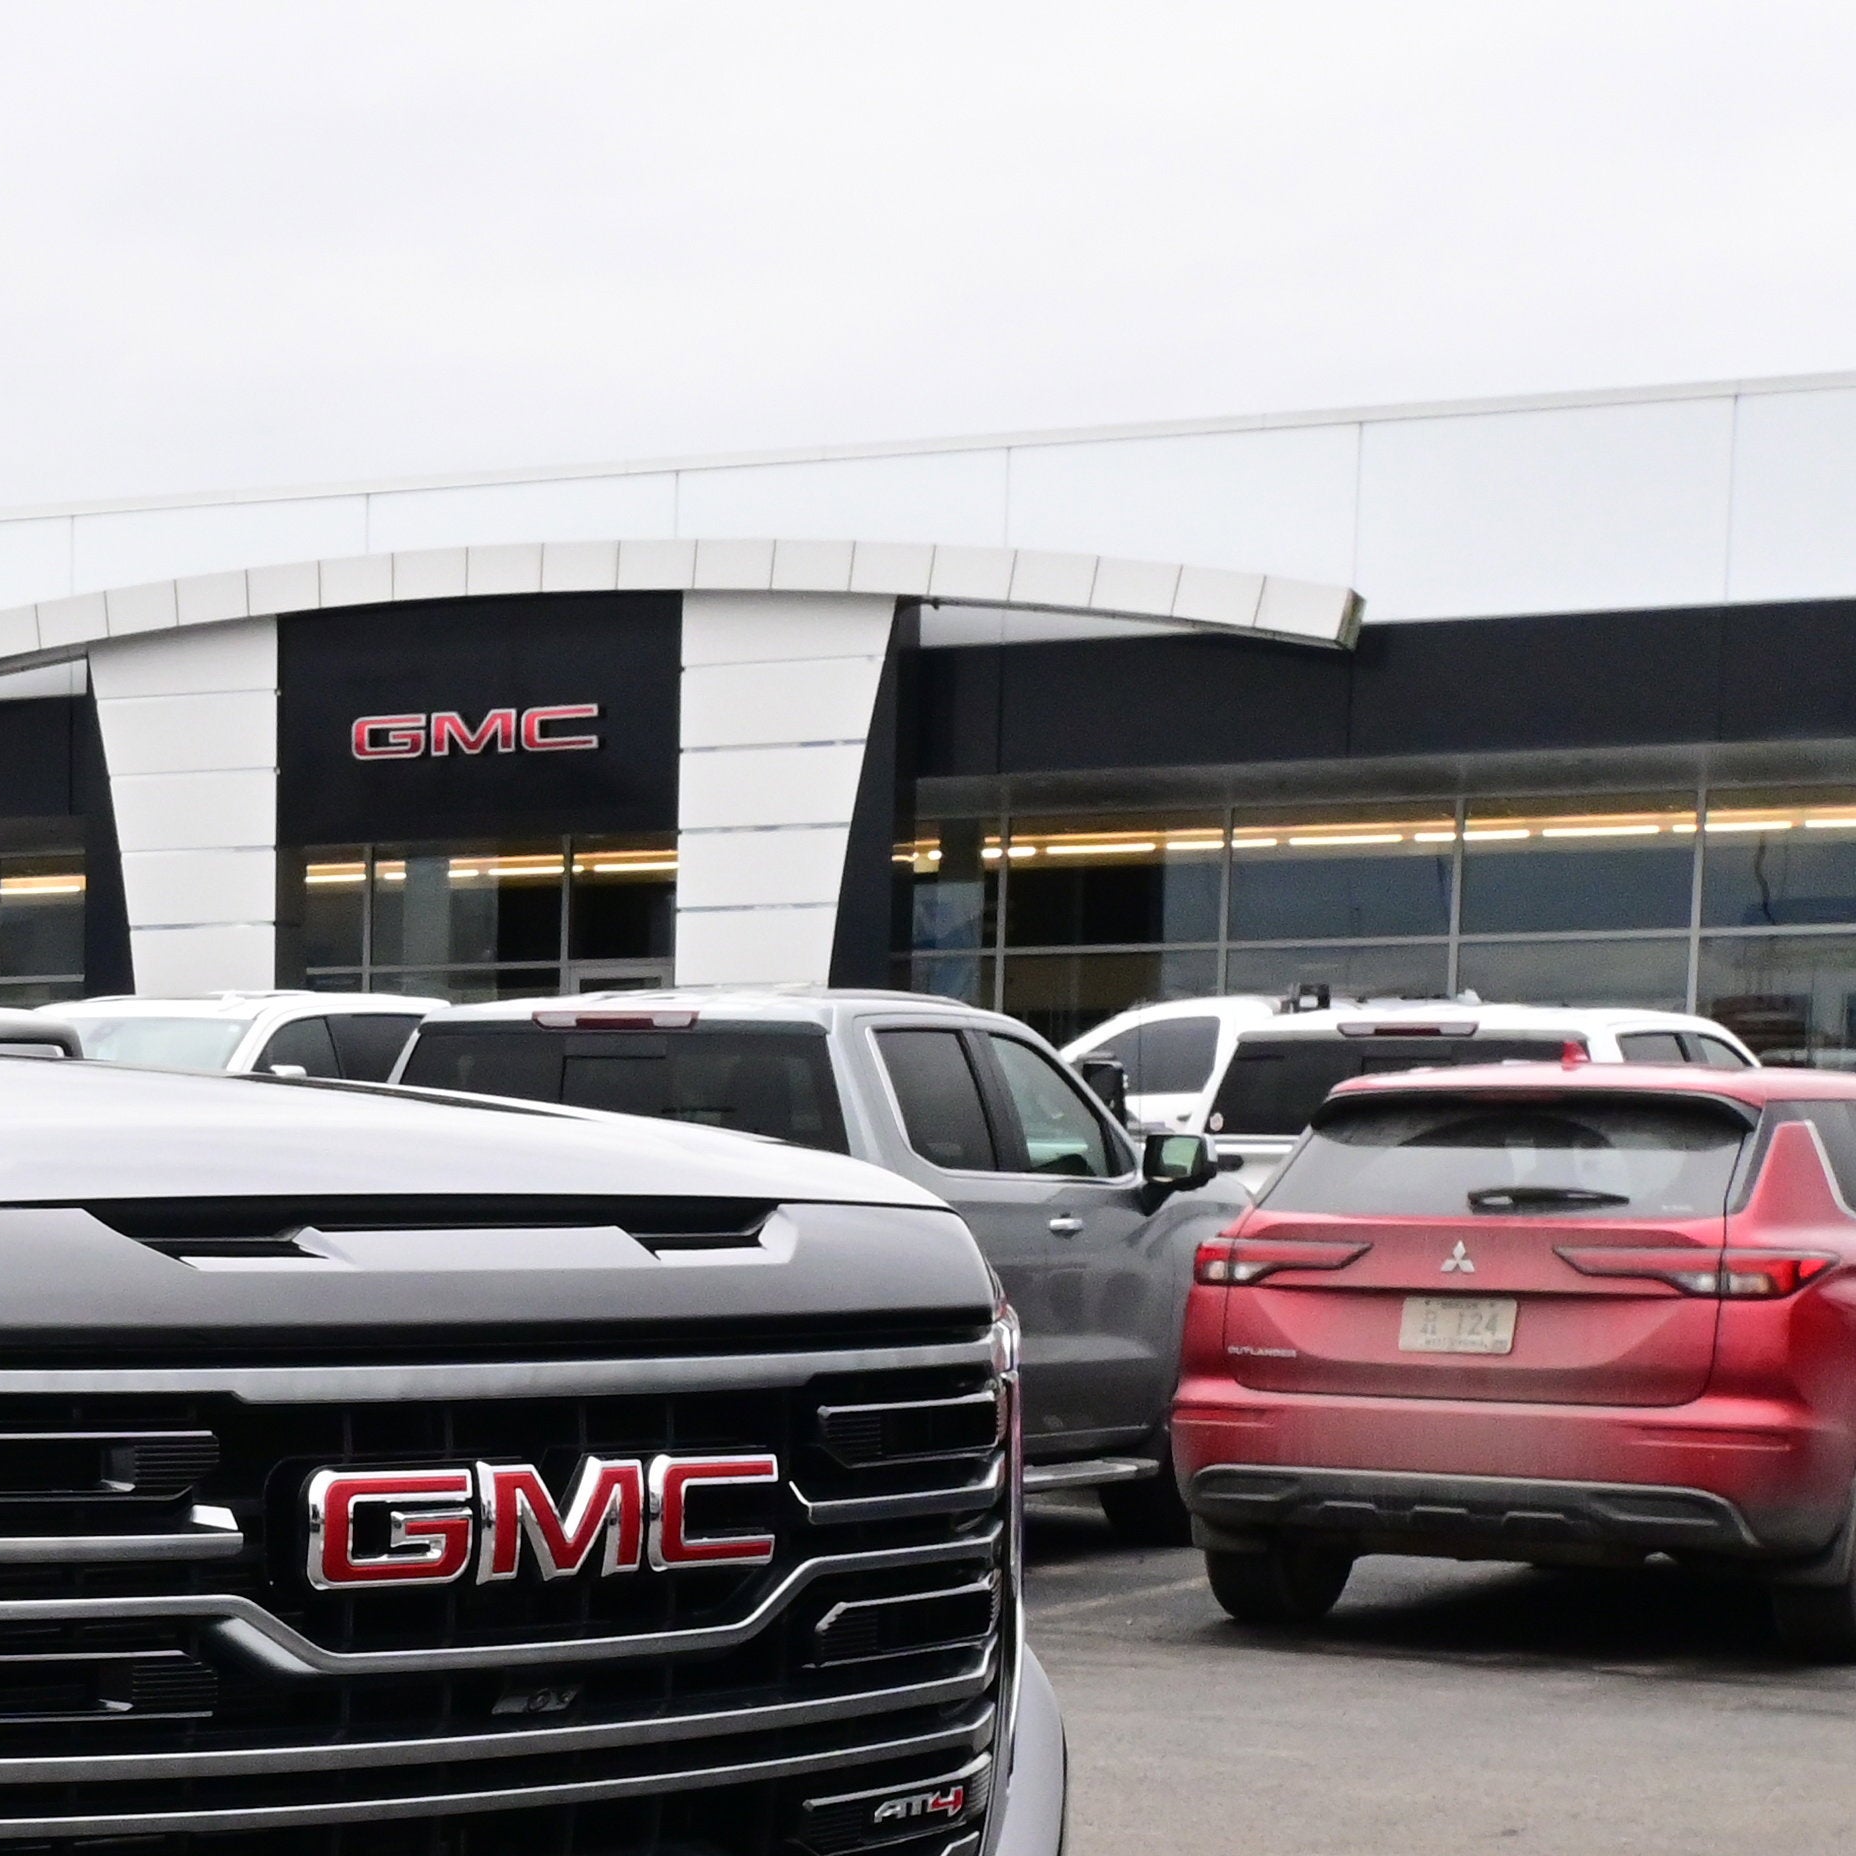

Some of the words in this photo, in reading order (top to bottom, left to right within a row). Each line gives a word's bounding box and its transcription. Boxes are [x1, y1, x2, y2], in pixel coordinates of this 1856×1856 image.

[351, 703, 599, 760] GMC
[307, 1453, 779, 1590] GMC
[873, 1785, 964, 1823] AT4
